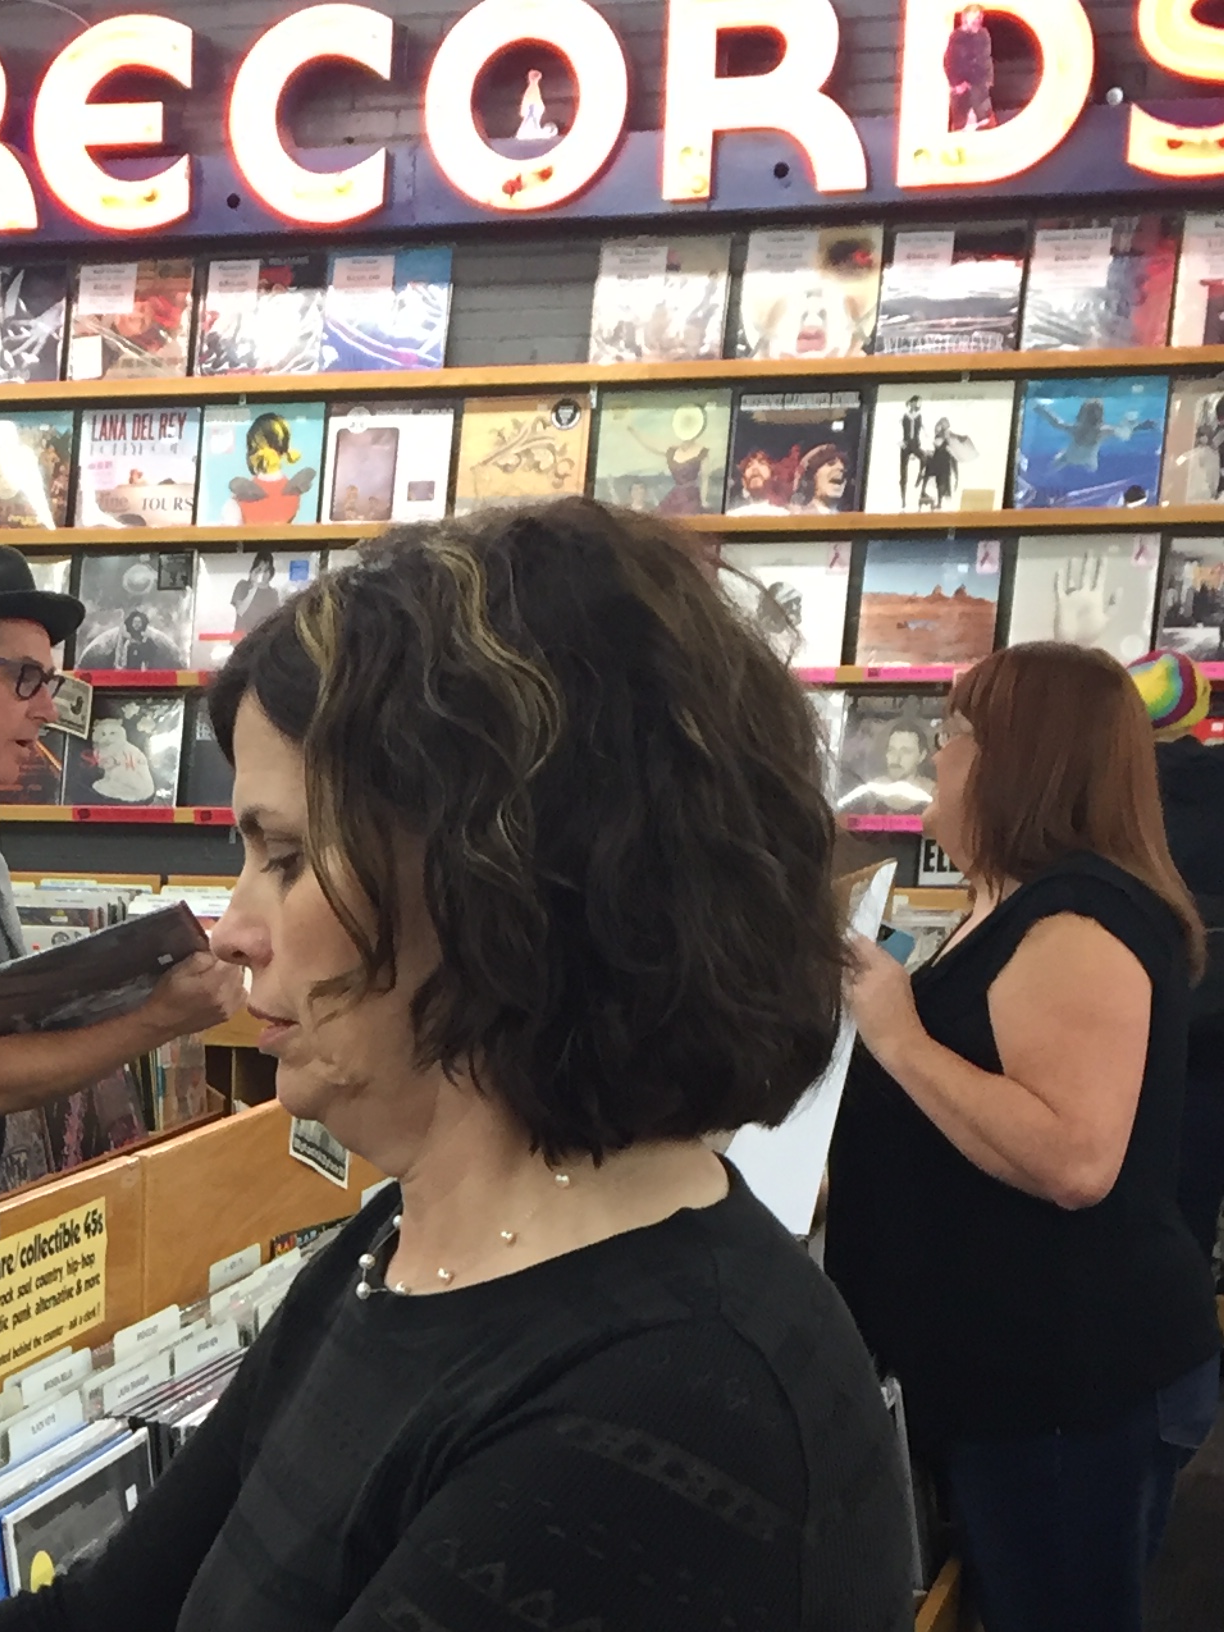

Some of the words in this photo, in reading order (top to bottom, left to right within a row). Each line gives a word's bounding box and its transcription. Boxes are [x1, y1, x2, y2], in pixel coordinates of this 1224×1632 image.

[91, 412, 128, 442] LANA
[131, 411, 156, 441] DEL
[83, 1208, 104, 1240] 45s
[16, 1276, 33, 1300] soul
[66, 1252, 96, 1277] hip-hop
[12, 1302, 32, 1330] punk
[34, 1283, 75, 1315] alternative
[83, 1272, 101, 1293] more
